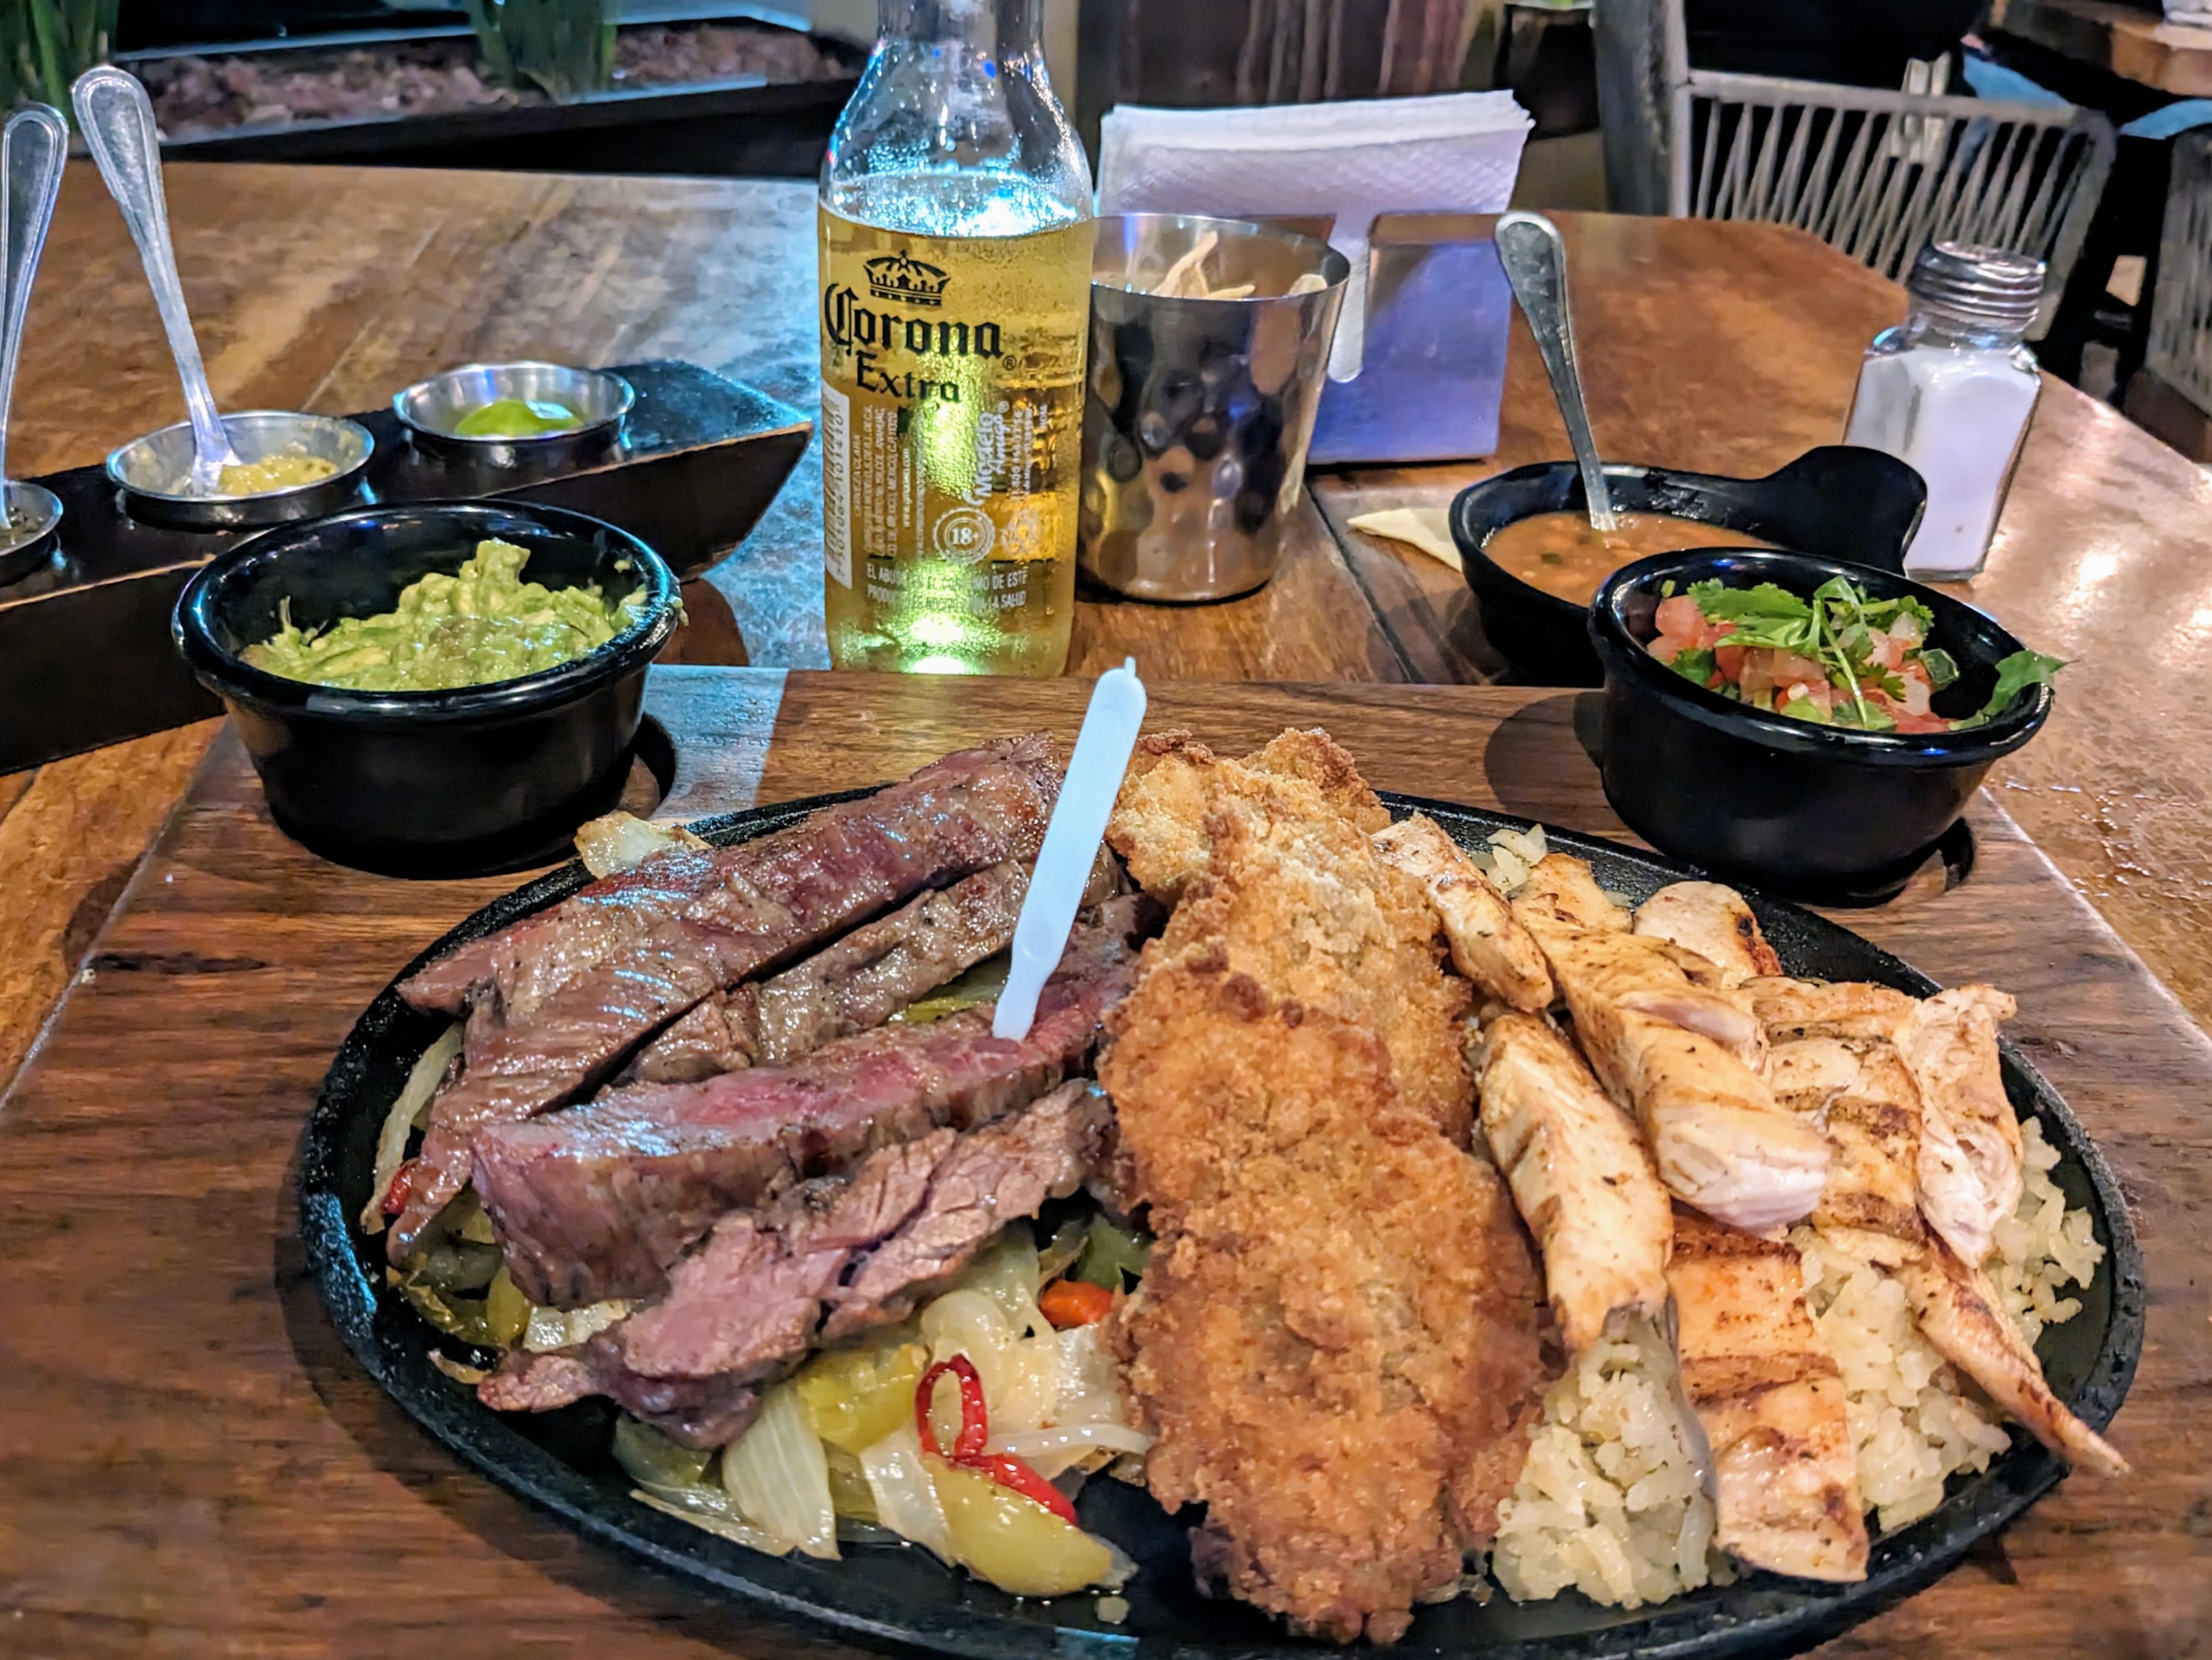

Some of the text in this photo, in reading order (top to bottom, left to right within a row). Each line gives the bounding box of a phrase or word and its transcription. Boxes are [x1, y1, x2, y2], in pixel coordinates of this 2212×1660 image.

[825, 283, 1003, 359] Corona
[856, 350, 961, 402] Extra
[853, 435, 861, 469] CLARA
[975, 413, 993, 497] Modelo
[987, 414, 1010, 475] Amigo
[952, 528, 979, 544] 18+
[867, 563, 877, 580] EL
[992, 575, 1005, 590] DE
[1007, 570, 1027, 588] ESTE
